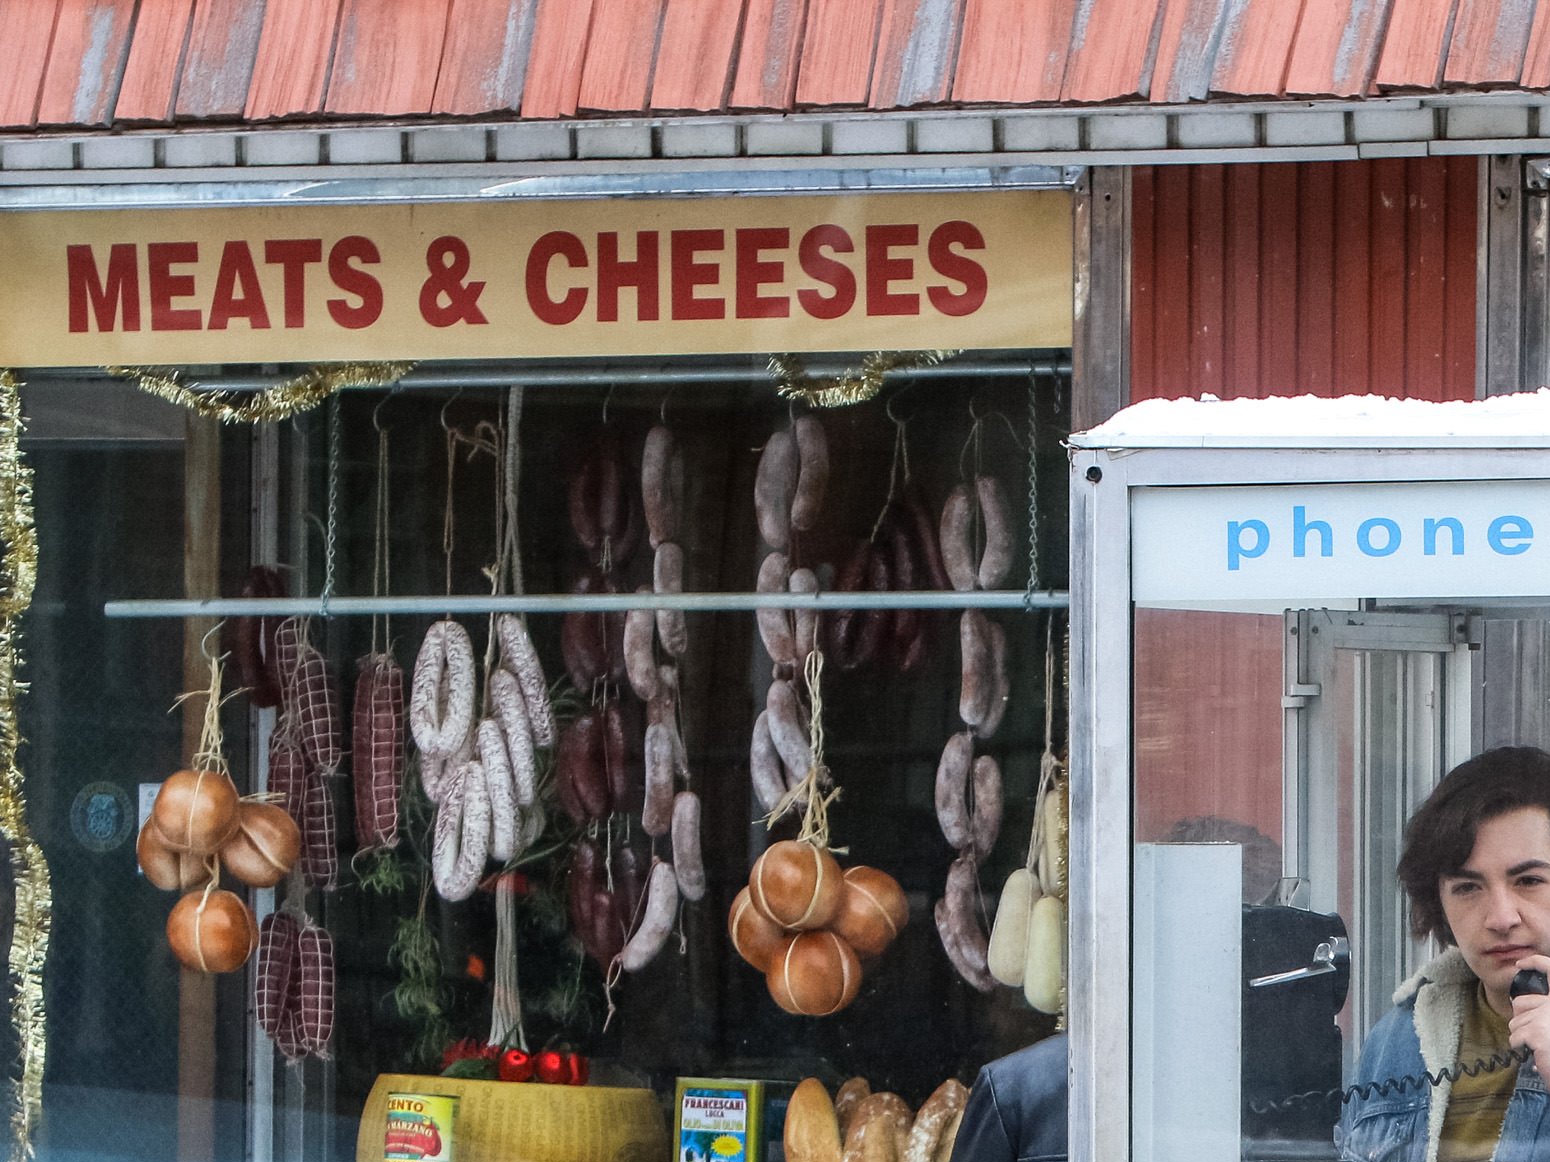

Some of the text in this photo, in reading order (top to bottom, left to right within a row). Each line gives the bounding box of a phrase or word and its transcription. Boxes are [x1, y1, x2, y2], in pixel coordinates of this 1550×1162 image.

[68, 221, 989, 332] MEATS & CHEESES
[1227, 505, 1536, 571] phone
